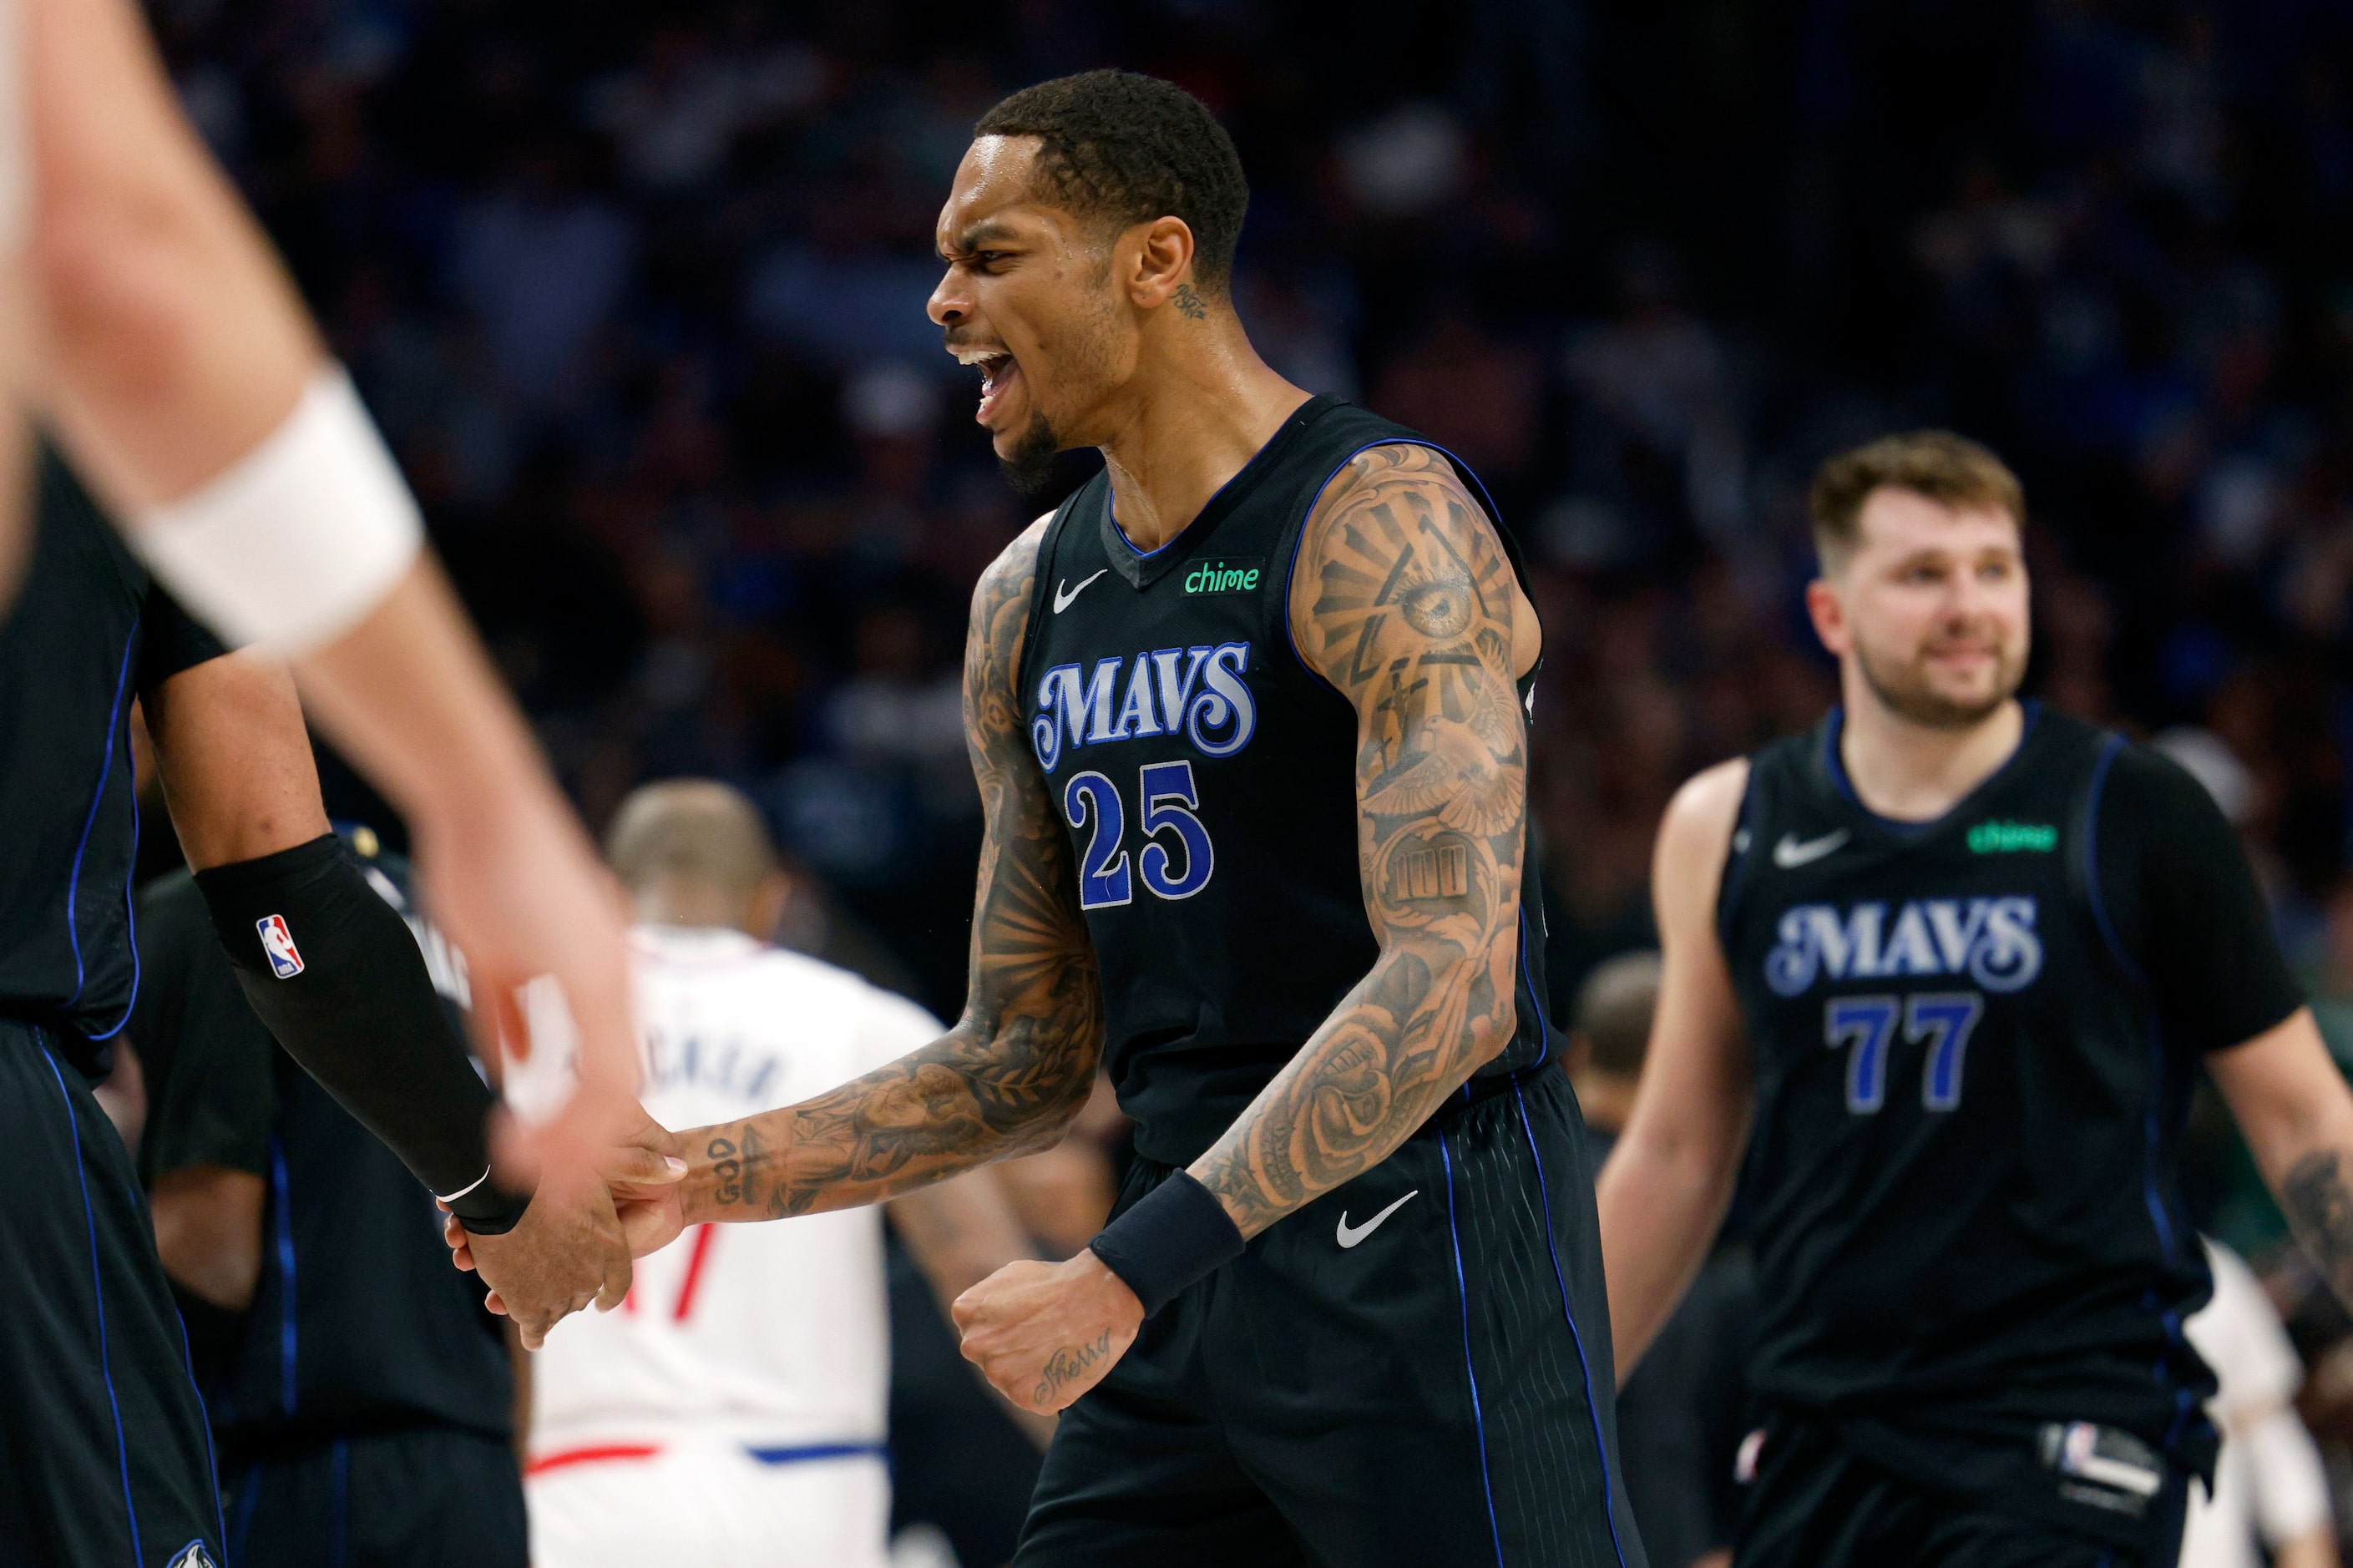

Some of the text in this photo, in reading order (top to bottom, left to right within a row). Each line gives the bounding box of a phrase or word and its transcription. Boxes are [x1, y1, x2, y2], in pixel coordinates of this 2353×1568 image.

[1185, 561, 1259, 594] chime
[1033, 641, 1257, 774] MAVS
[1064, 760, 1214, 911] 25
[1764, 894, 2044, 997] MAVS
[1823, 993, 1984, 1114] 77
[707, 1138, 741, 1205] GOD
